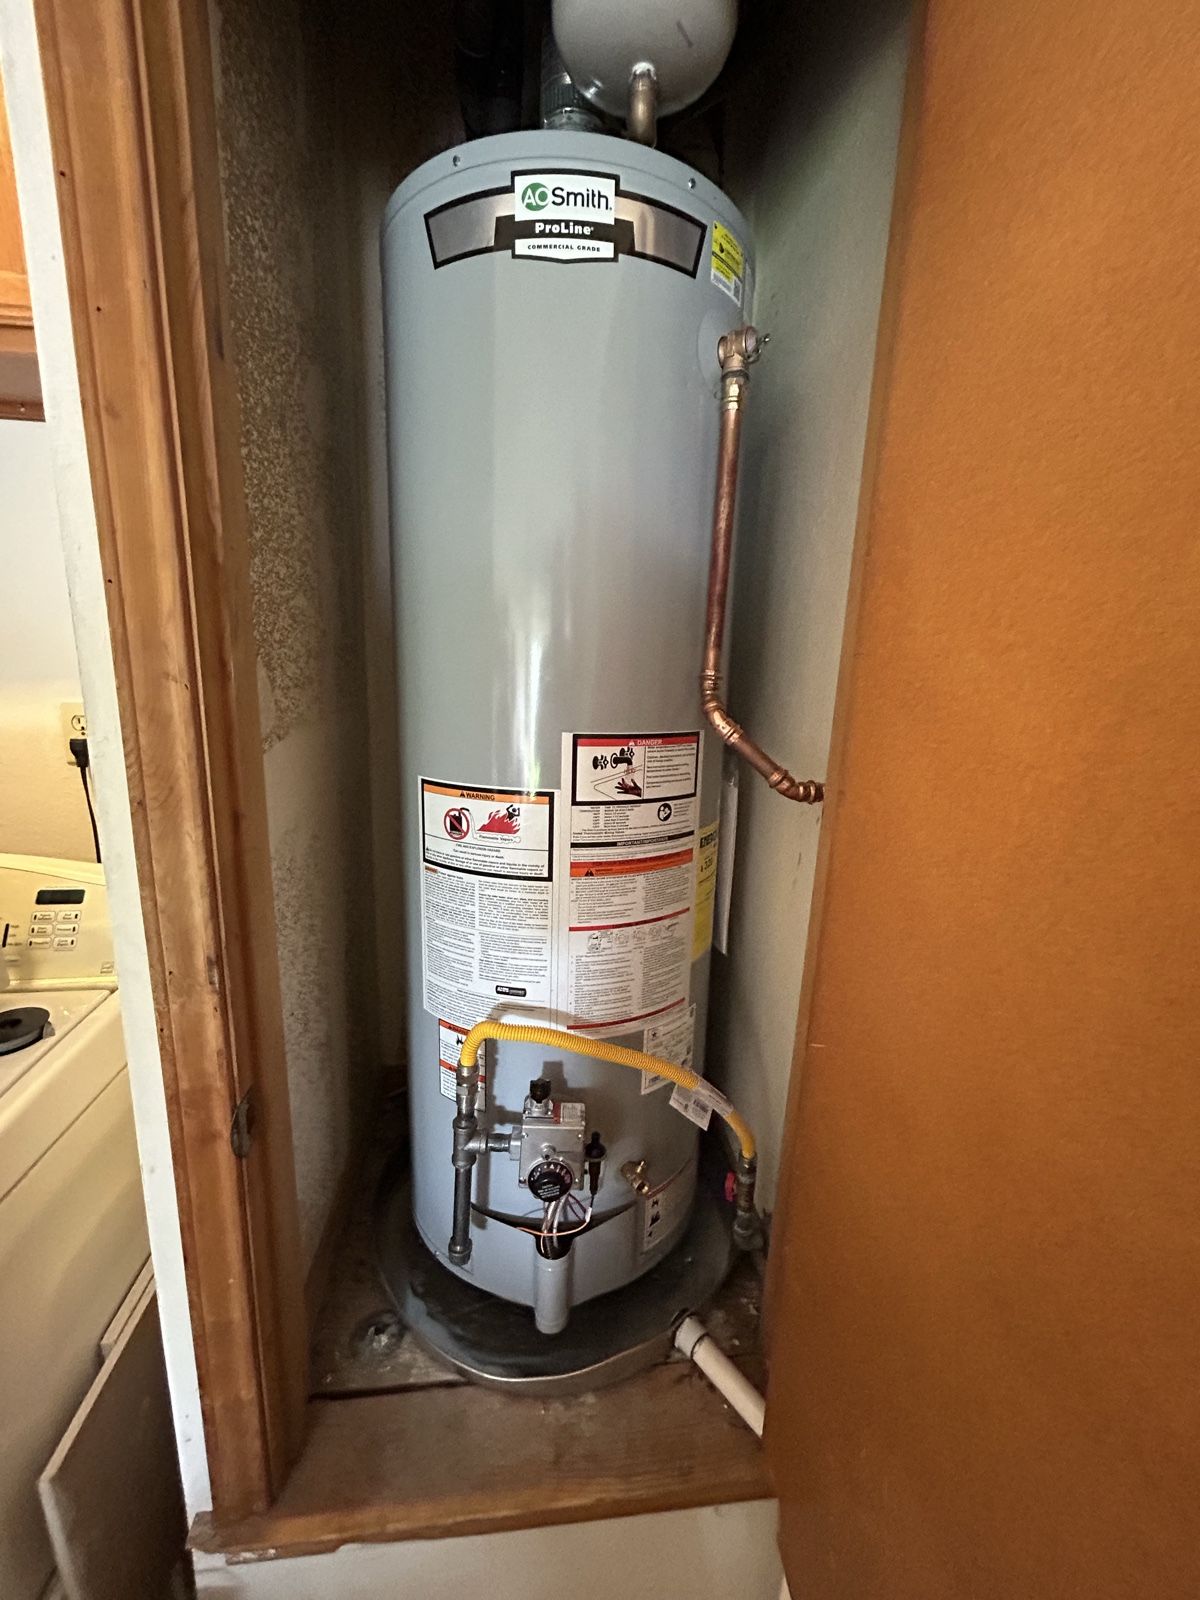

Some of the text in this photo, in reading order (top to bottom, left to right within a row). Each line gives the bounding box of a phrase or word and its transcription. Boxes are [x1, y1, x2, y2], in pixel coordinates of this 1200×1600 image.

[551, 187, 609, 210] Smith
[535, 222, 591, 235] ProLine
[465, 791, 496, 801] WARNING
